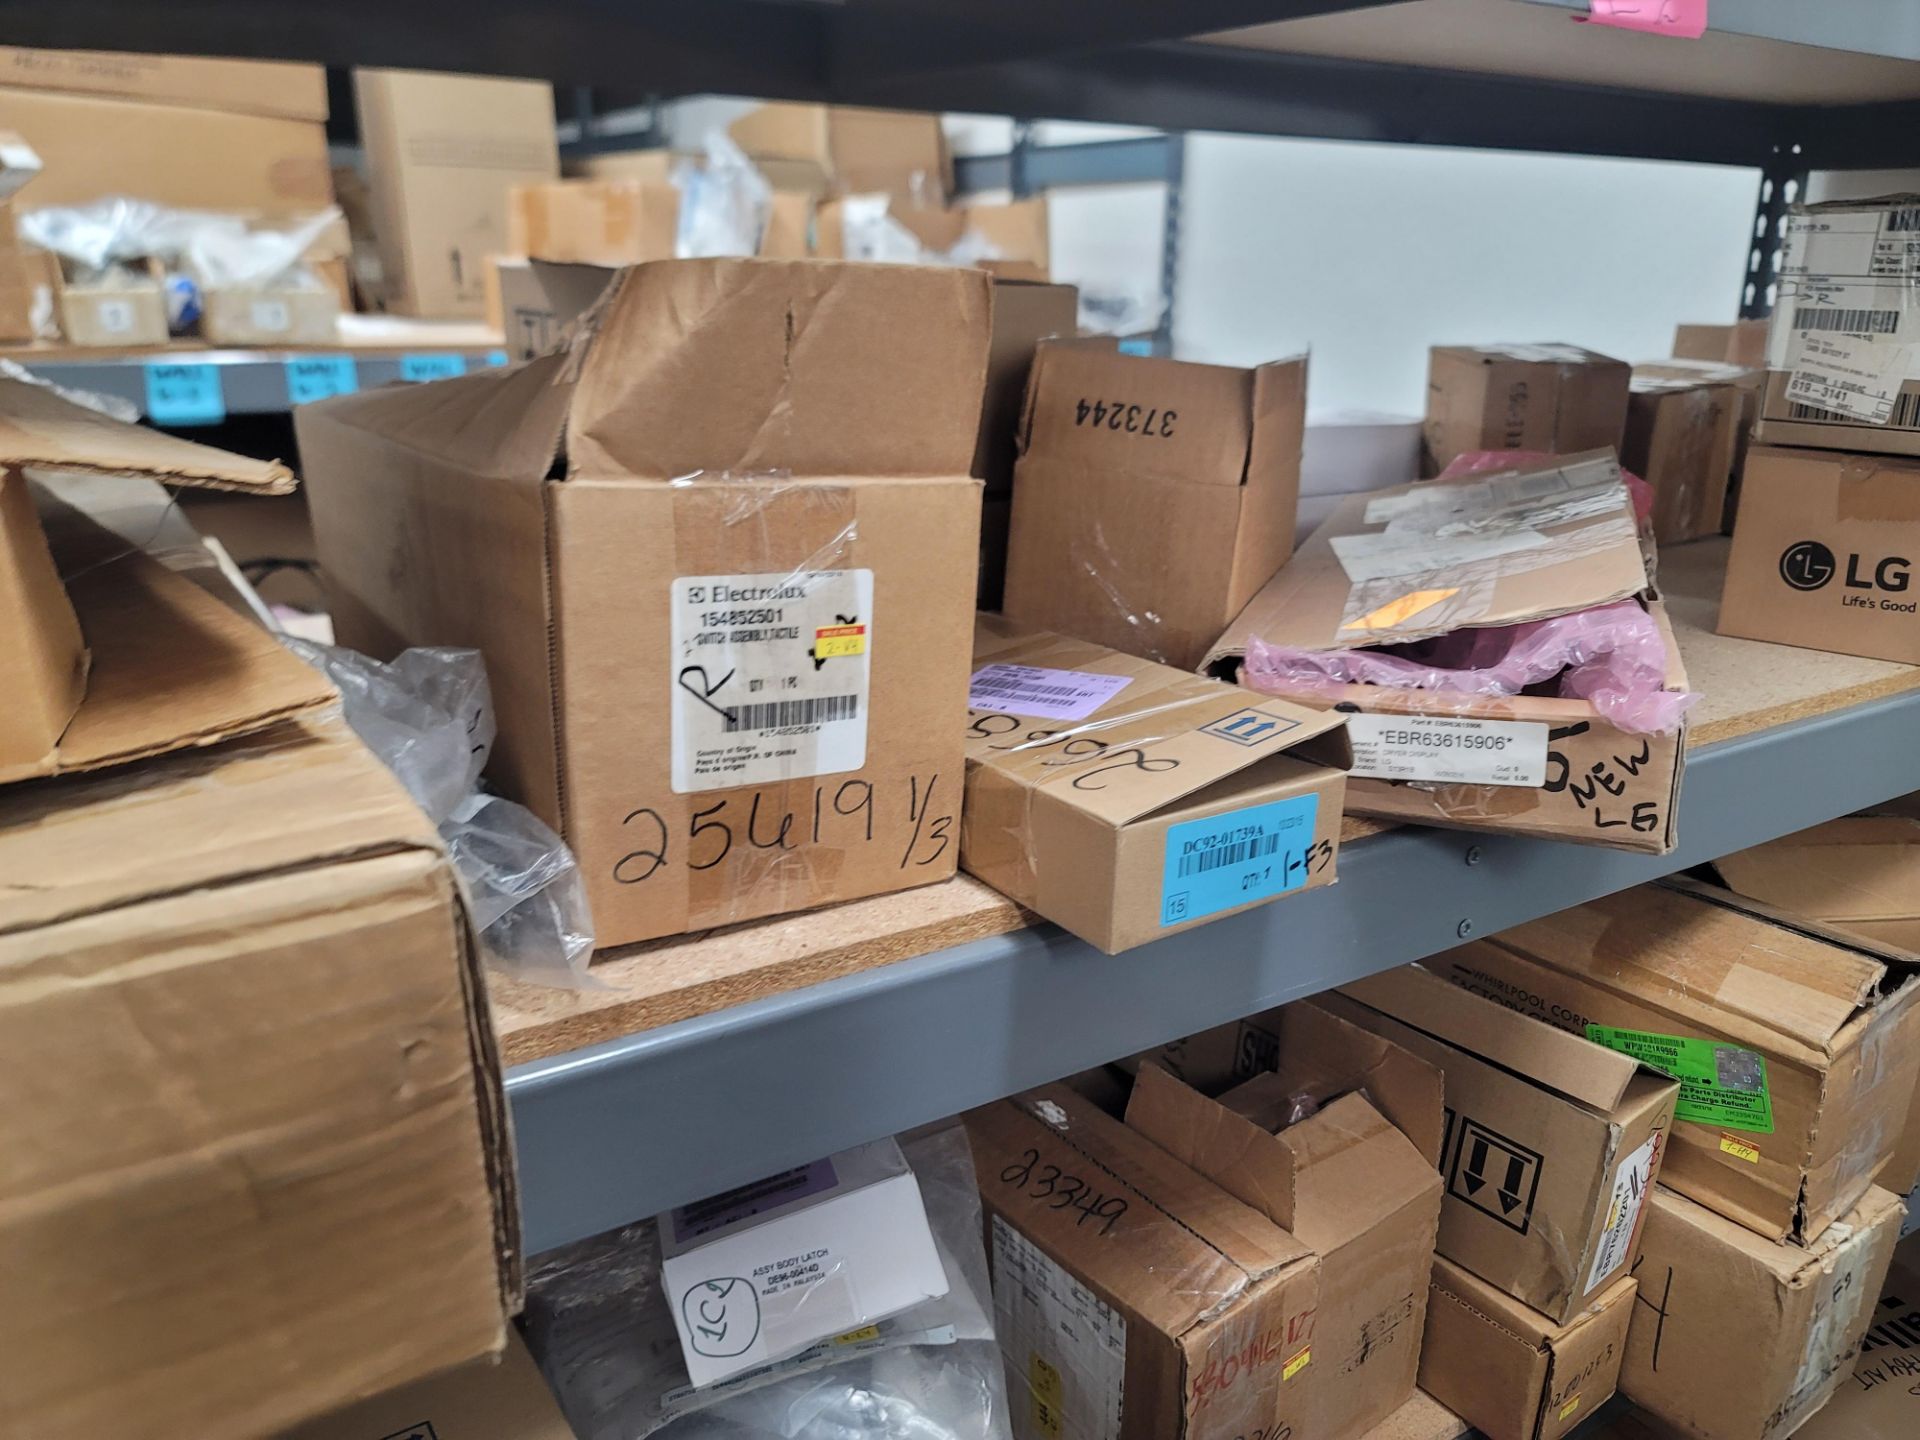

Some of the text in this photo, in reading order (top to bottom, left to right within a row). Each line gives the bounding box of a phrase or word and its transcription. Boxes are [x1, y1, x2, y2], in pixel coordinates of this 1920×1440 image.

[1076, 398, 1178, 438] 373244
[1845, 553, 1912, 592] LG
[712, 585, 807, 603] Electrolux
[1842, 595, 1917, 613] Life's Good
[700, 608, 783, 627] 154852501
[1183, 824, 1265, 854] DC92-01739A
[1170, 898, 1185, 915] 15
[1472, 968, 1546, 1011] WHIRLPOOL
[1713, 1092, 1756, 1103] Distributor
[1000, 1149, 1128, 1236] 23349
[752, 1248, 829, 1277] ASSY BODY LATCH
